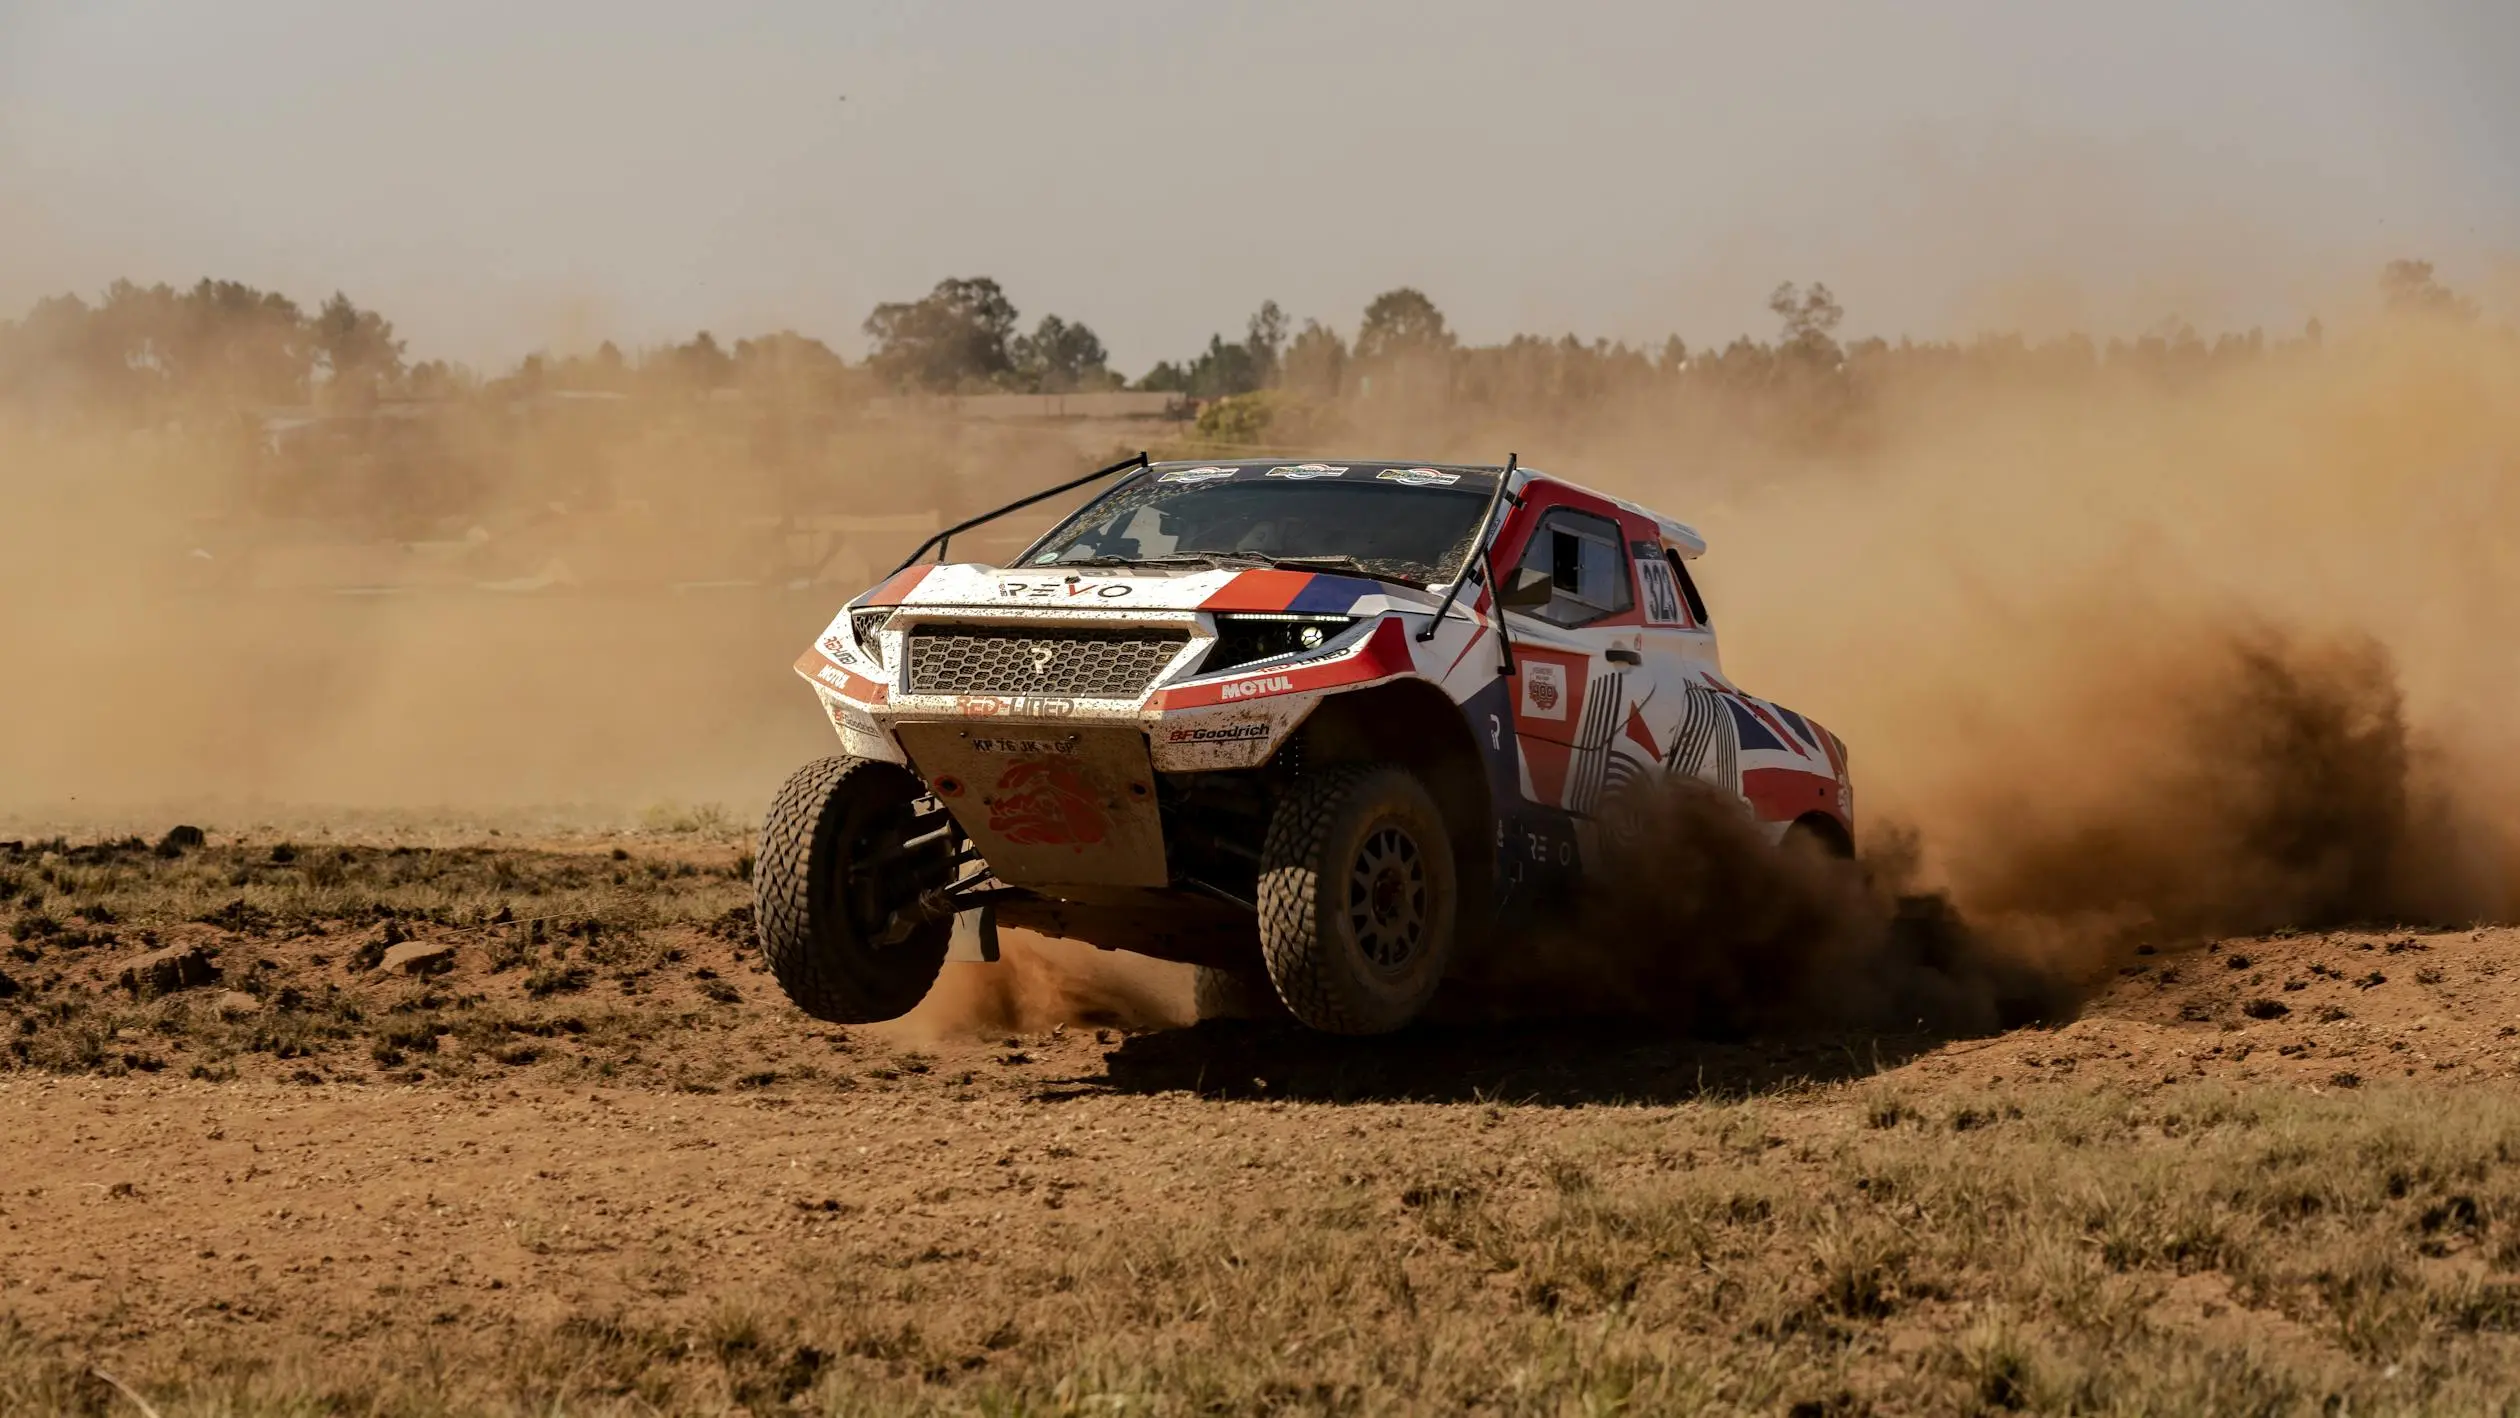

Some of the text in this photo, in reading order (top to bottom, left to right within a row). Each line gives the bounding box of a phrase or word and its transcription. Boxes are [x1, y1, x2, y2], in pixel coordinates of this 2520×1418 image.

[1007, 581, 1133, 598] REVO
[1643, 562, 1678, 623] 323
[817, 664, 851, 690] MOTUL
[1221, 675, 1293, 701] MOTUL
[1169, 723, 1270, 742] BFGoodrich
